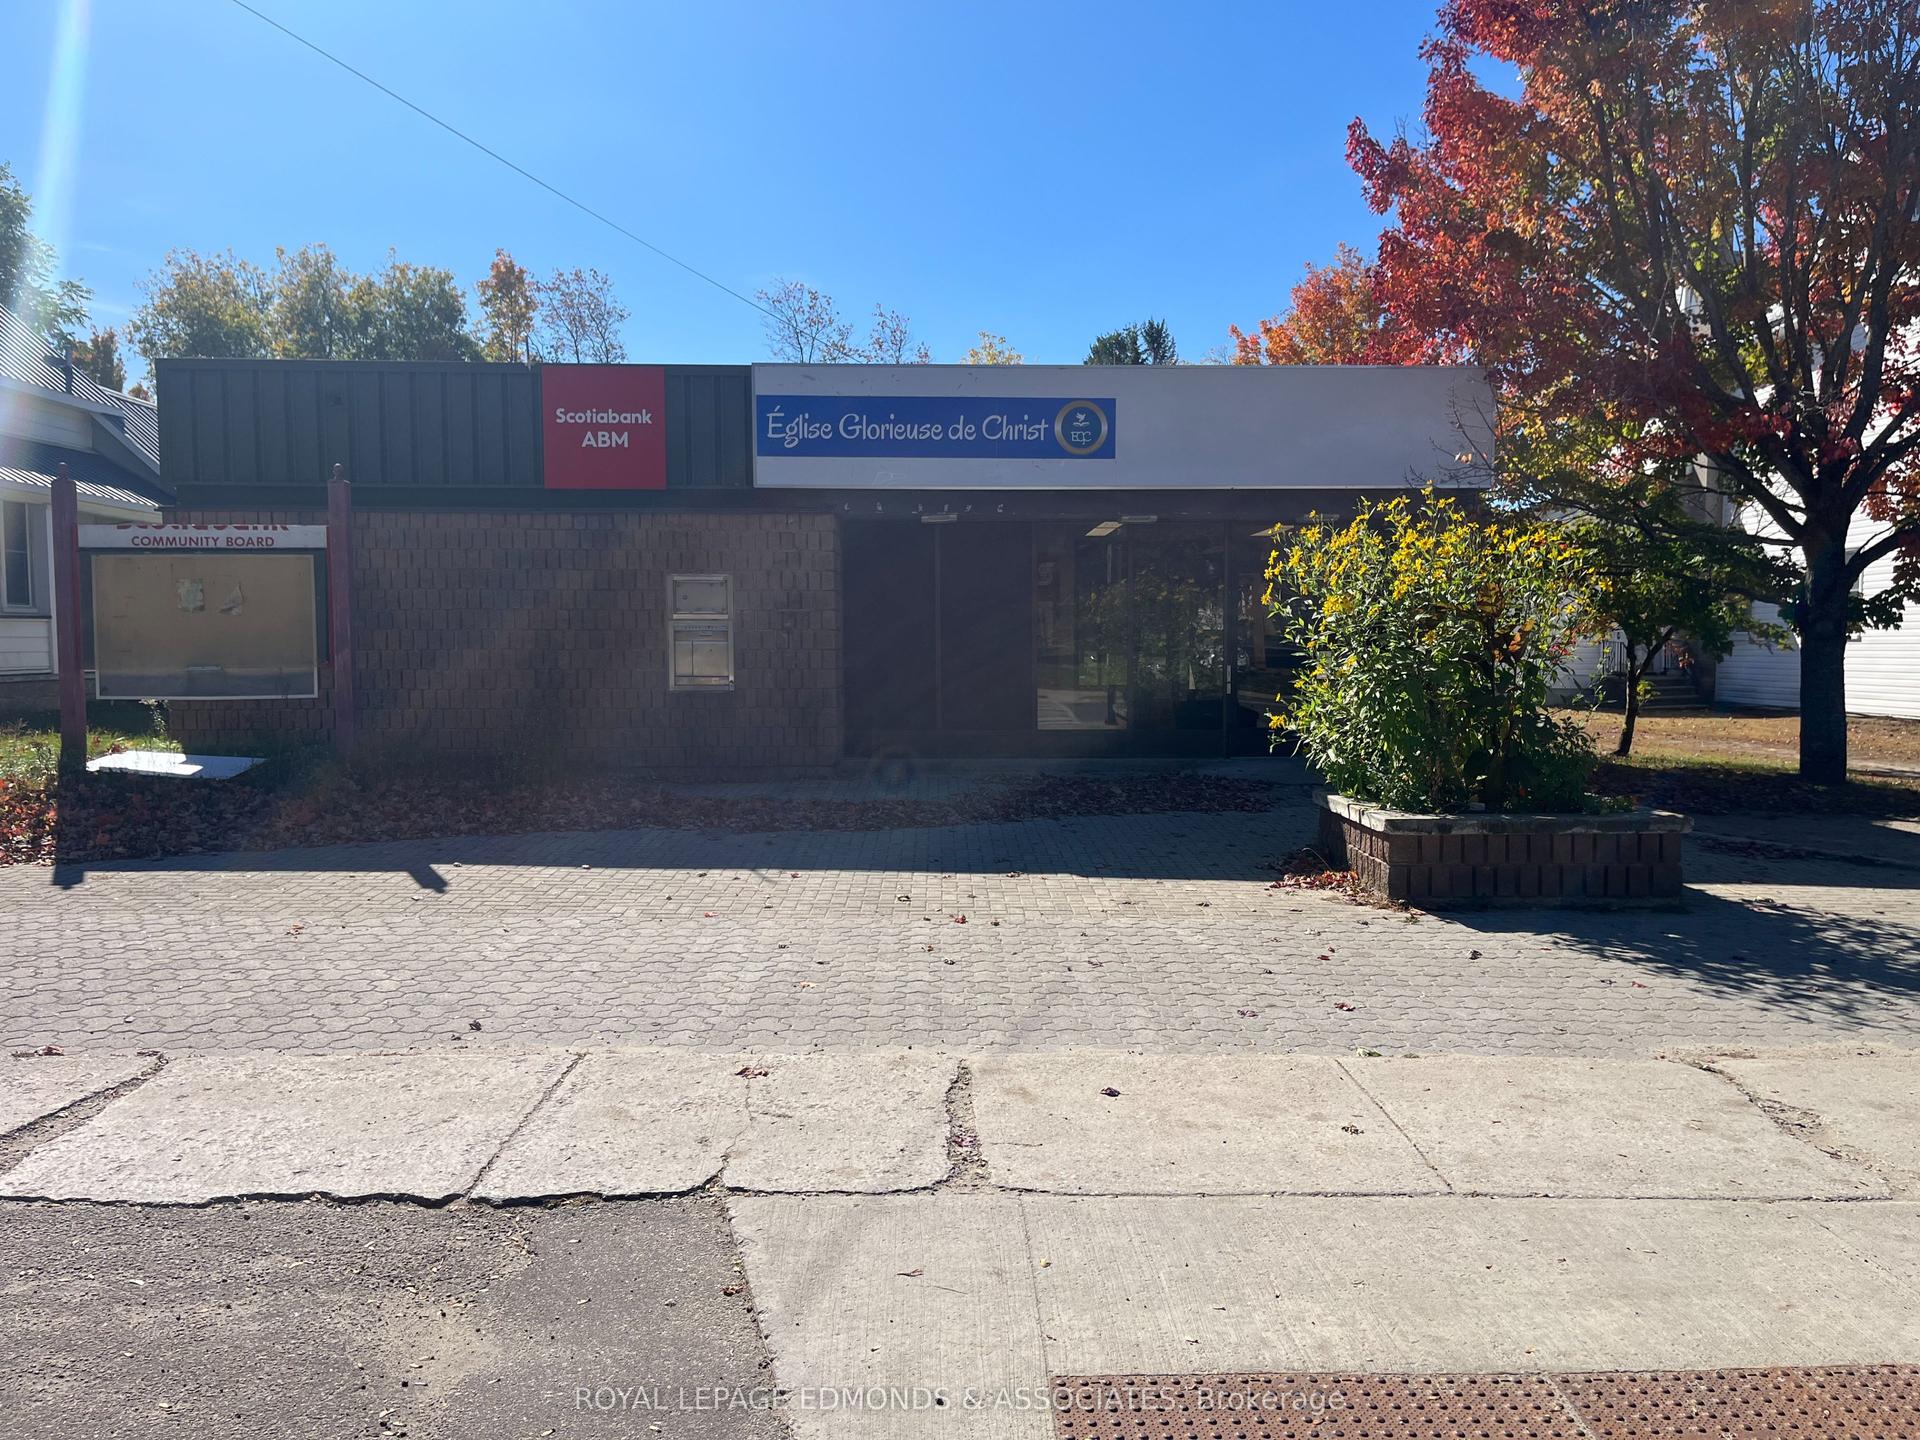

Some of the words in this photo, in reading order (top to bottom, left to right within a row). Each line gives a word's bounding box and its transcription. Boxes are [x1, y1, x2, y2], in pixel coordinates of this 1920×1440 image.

[555, 407, 653, 424] Scotiabank
[766, 405, 833, 448] Église
[838, 413, 944, 441] Glorieuse
[947, 415, 977, 440] de
[981, 414, 1048, 441] Christ
[581, 430, 629, 448] ABM
[131, 535, 220, 548] COMMUNITY
[225, 536, 275, 548] BOARD
